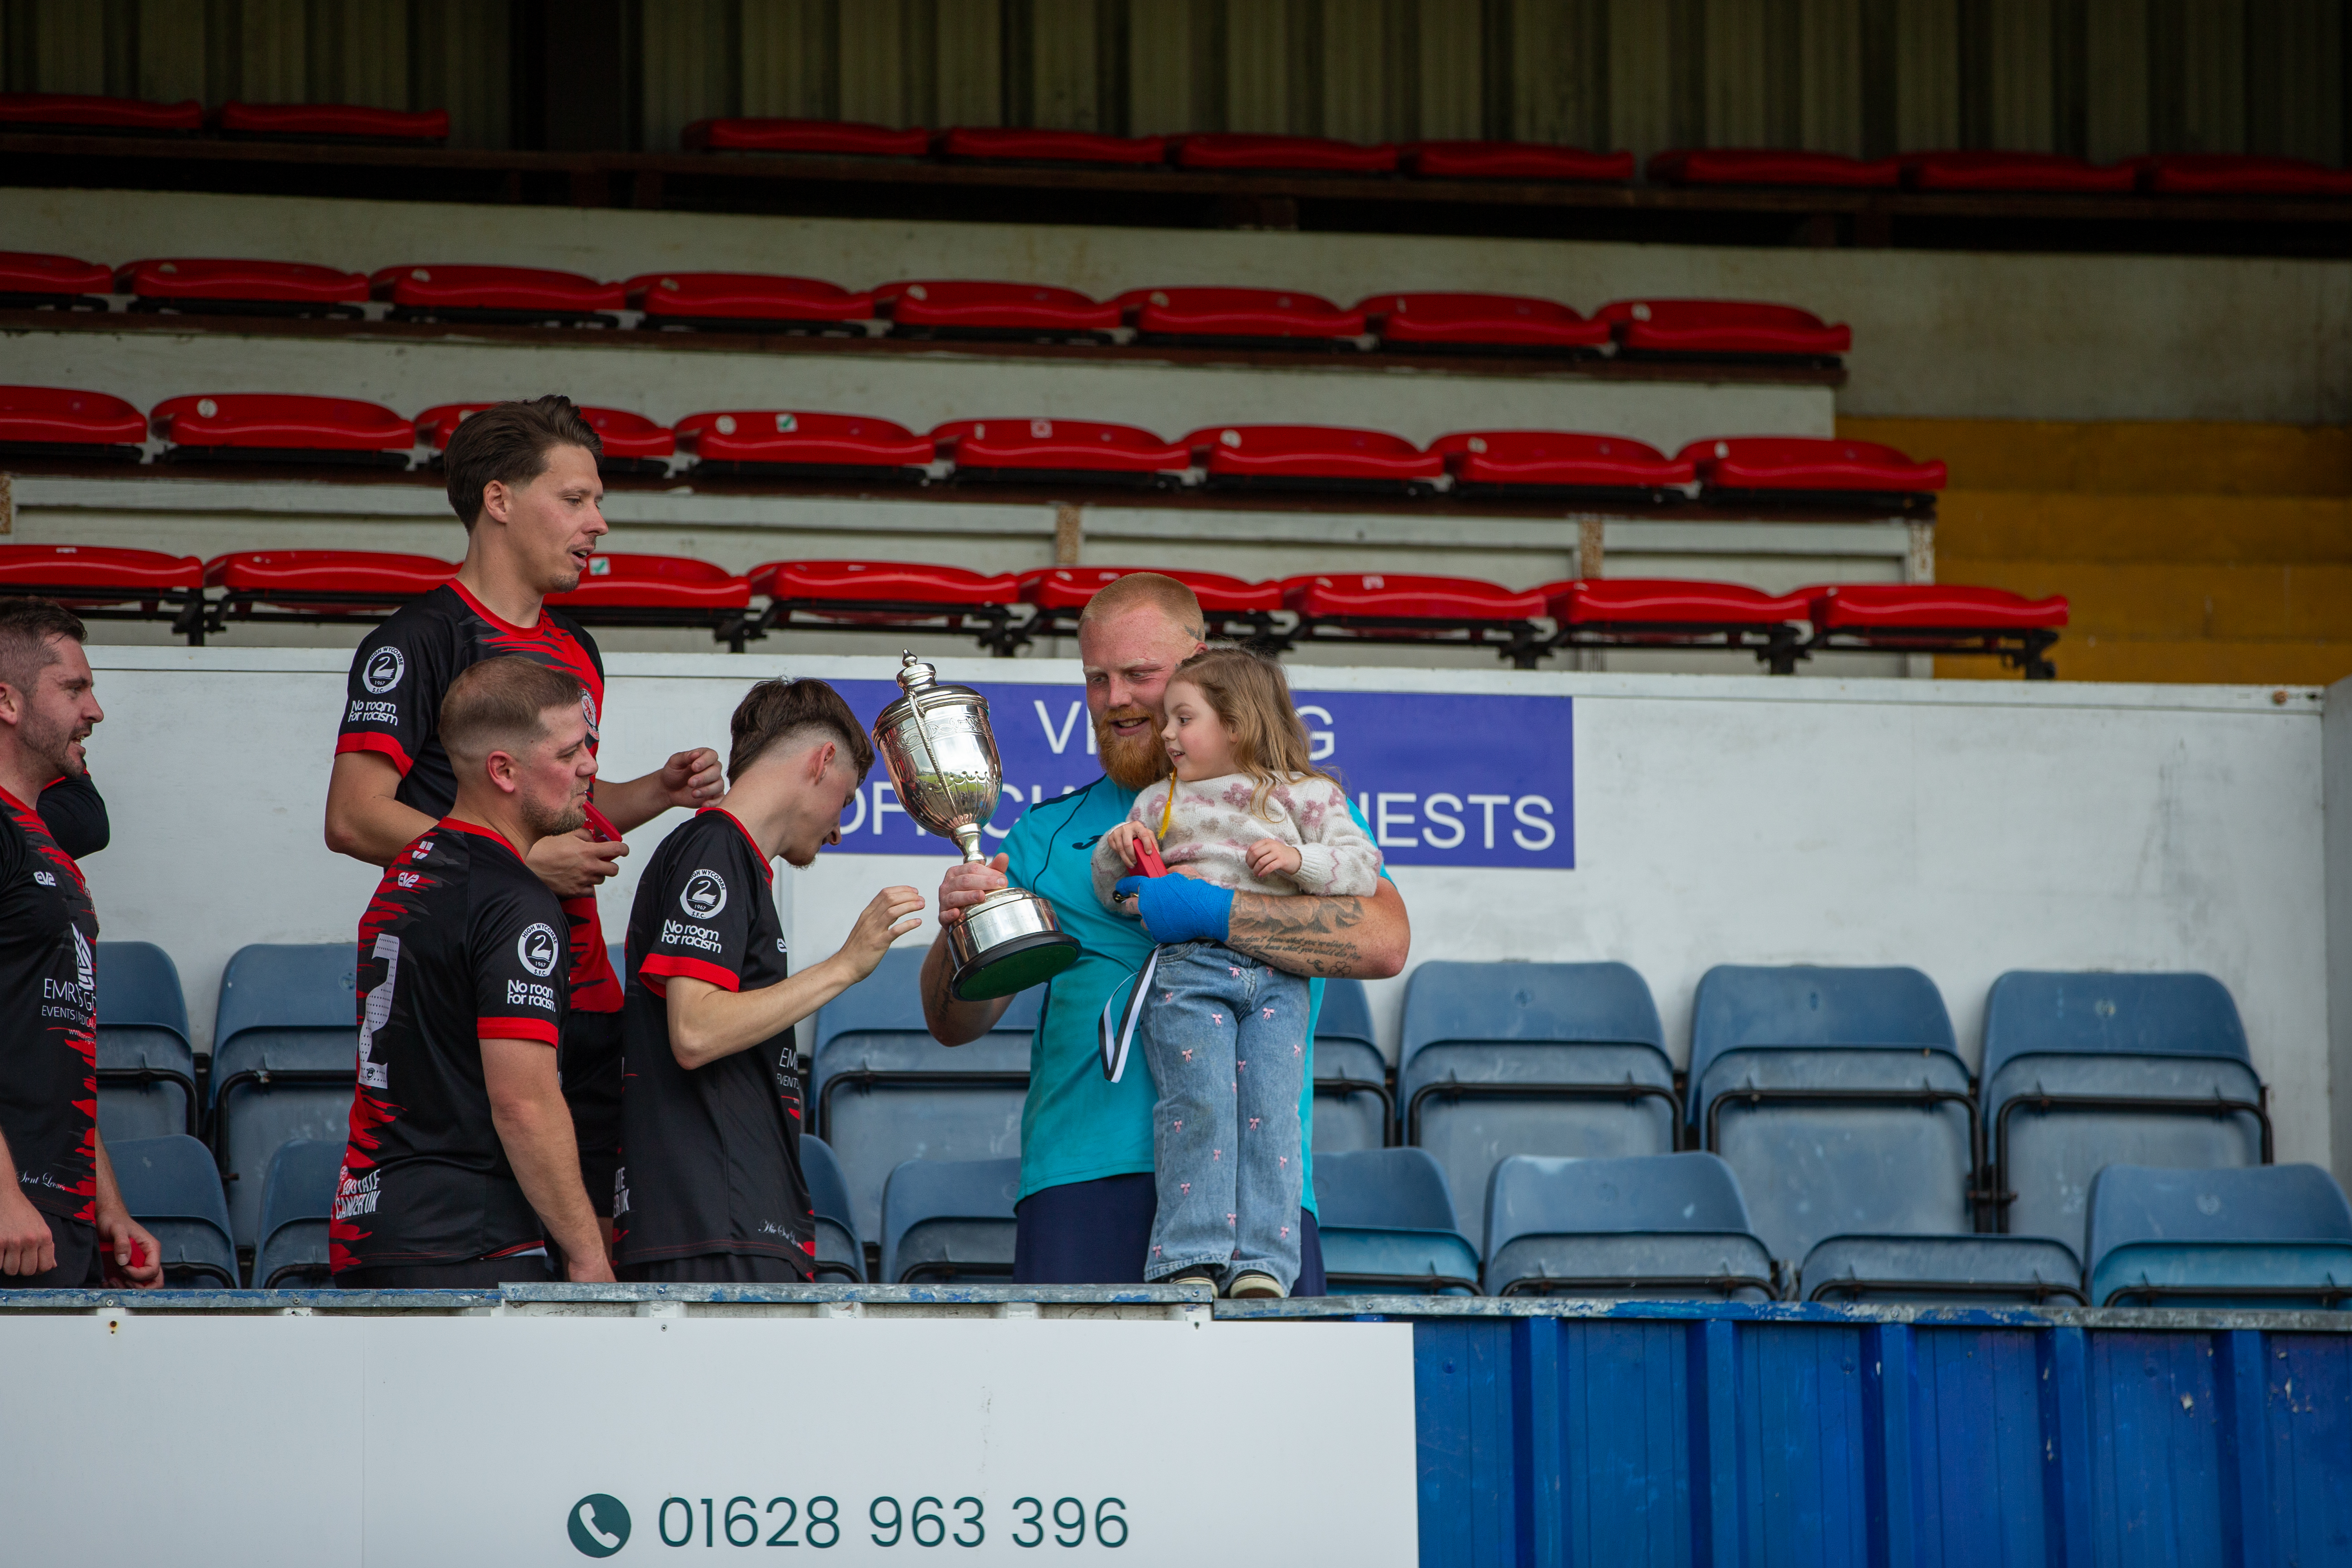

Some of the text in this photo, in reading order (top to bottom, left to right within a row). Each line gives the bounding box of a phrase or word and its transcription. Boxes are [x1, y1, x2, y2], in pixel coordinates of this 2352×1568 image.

[369, 647, 404, 666] HIGH WYCOMBE
[351, 700, 397, 714] No room
[363, 711, 398, 726] racism
[701, 870, 725, 891] WYCOMBE
[522, 923, 557, 945] HIGH WYCOMBE
[663, 919, 719, 941] No room
[681, 935, 722, 953] racism
[508, 979, 554, 1000] No room
[42, 1005, 75, 1020] EVENTS
[358, 933, 399, 1089] 2
[528, 995, 556, 1012] racism
[336, 1191, 381, 1220] CANCER UK
[659, 1496, 1129, 1548] 01628 963 396
